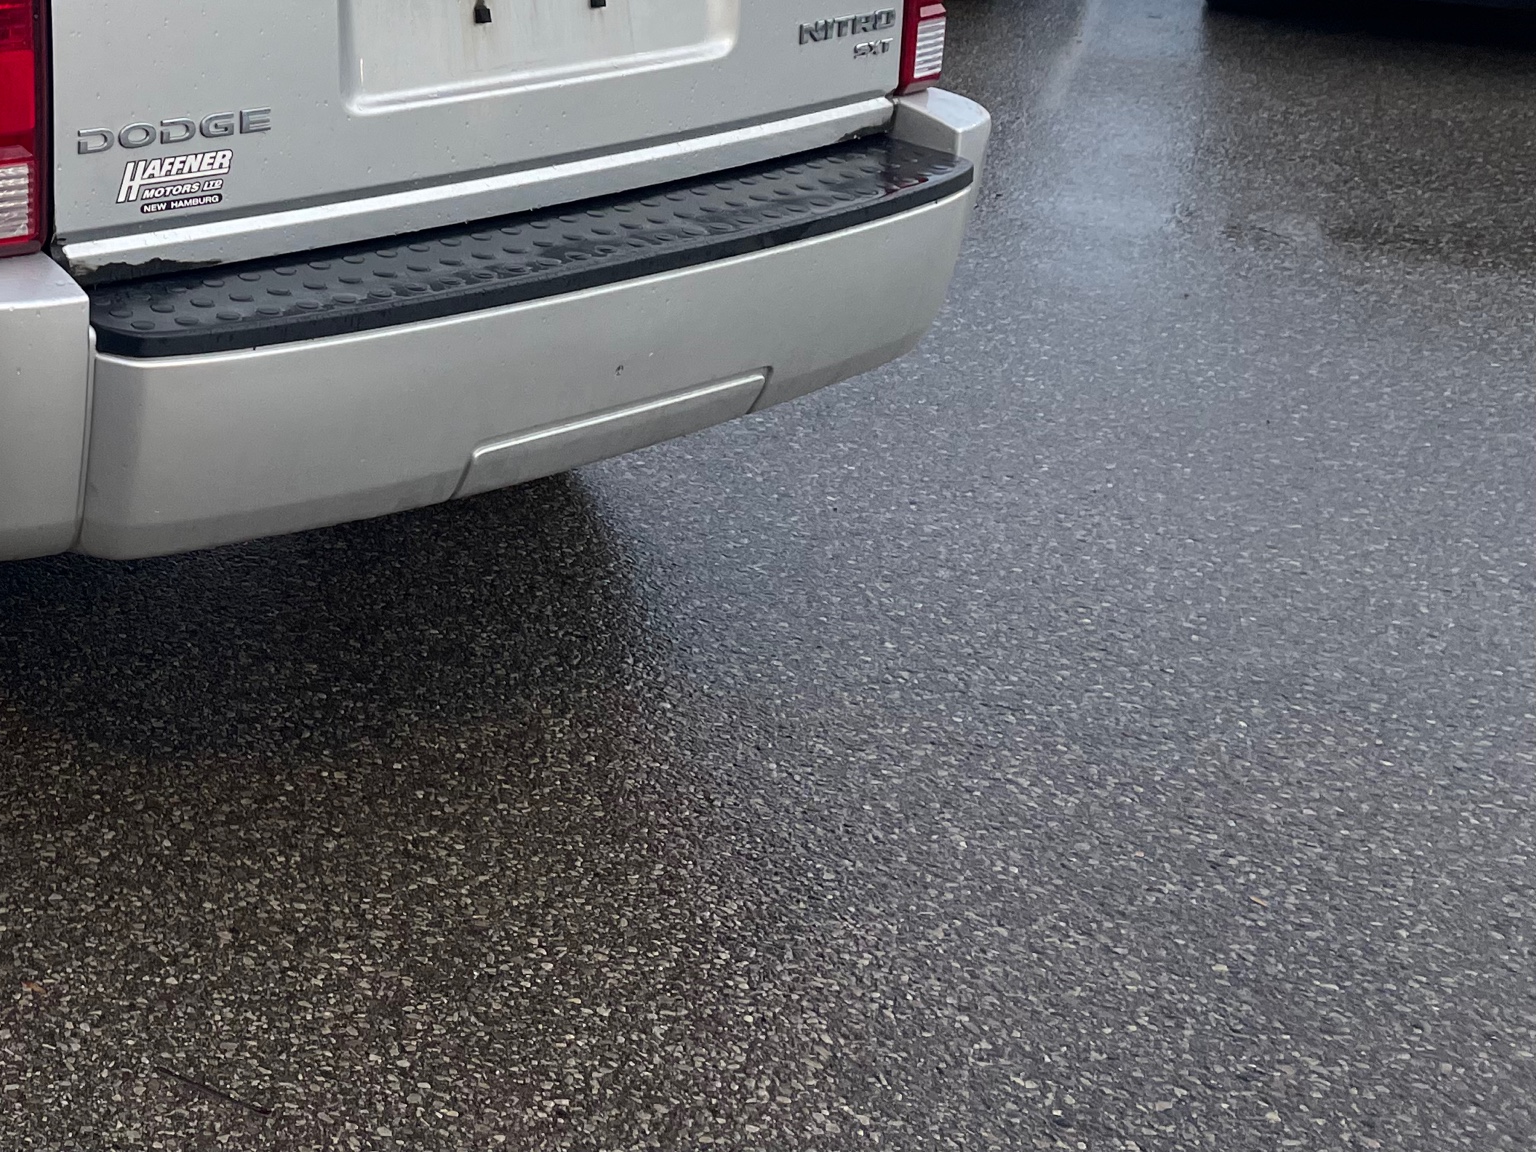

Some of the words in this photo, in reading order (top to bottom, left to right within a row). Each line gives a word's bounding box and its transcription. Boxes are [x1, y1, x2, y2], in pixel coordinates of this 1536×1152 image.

[799, 8, 896, 45] NITRO
[77, 106, 271, 155] DODGE
[116, 149, 233, 203] HAFFNER
[141, 181, 200, 199] MOTORS
[202, 178, 224, 192] LTD
[143, 202, 167, 214] NEW
[170, 194, 220, 210] HAMBURG
